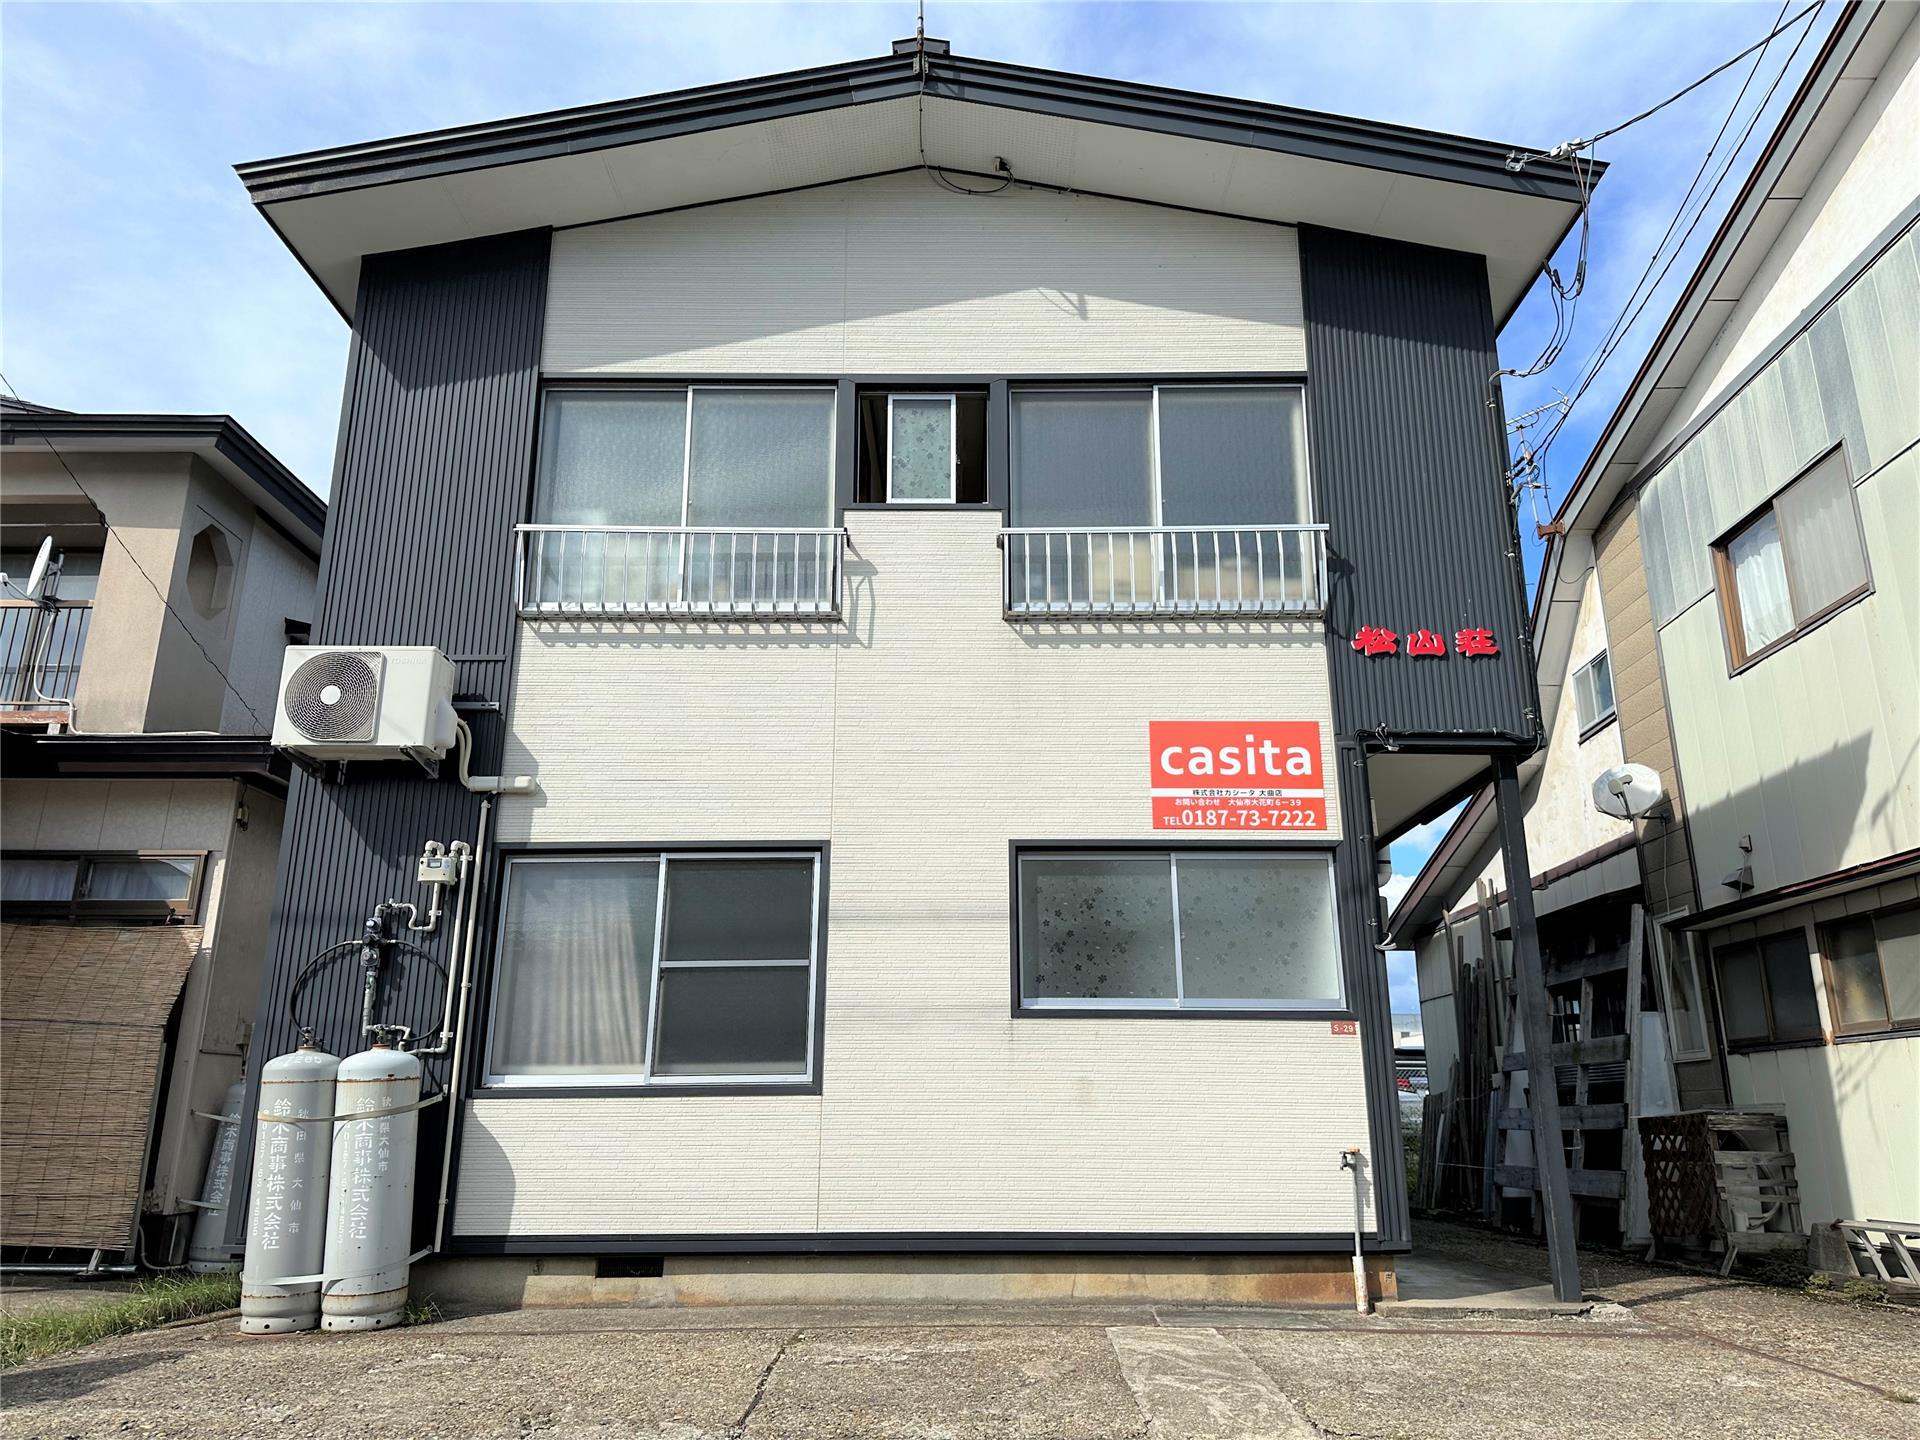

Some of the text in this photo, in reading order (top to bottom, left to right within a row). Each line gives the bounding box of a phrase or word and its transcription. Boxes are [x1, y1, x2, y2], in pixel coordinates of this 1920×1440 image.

[1351, 626, 1498, 656] 松山荘
[1160, 734, 1312, 776] casita
[1175, 798, 1221, 807] お問い合わせ
[1192, 789, 1283, 797] 株式会社カシータ 大曲店
[378, 1096, 392, 1172] 秋県大仙市
